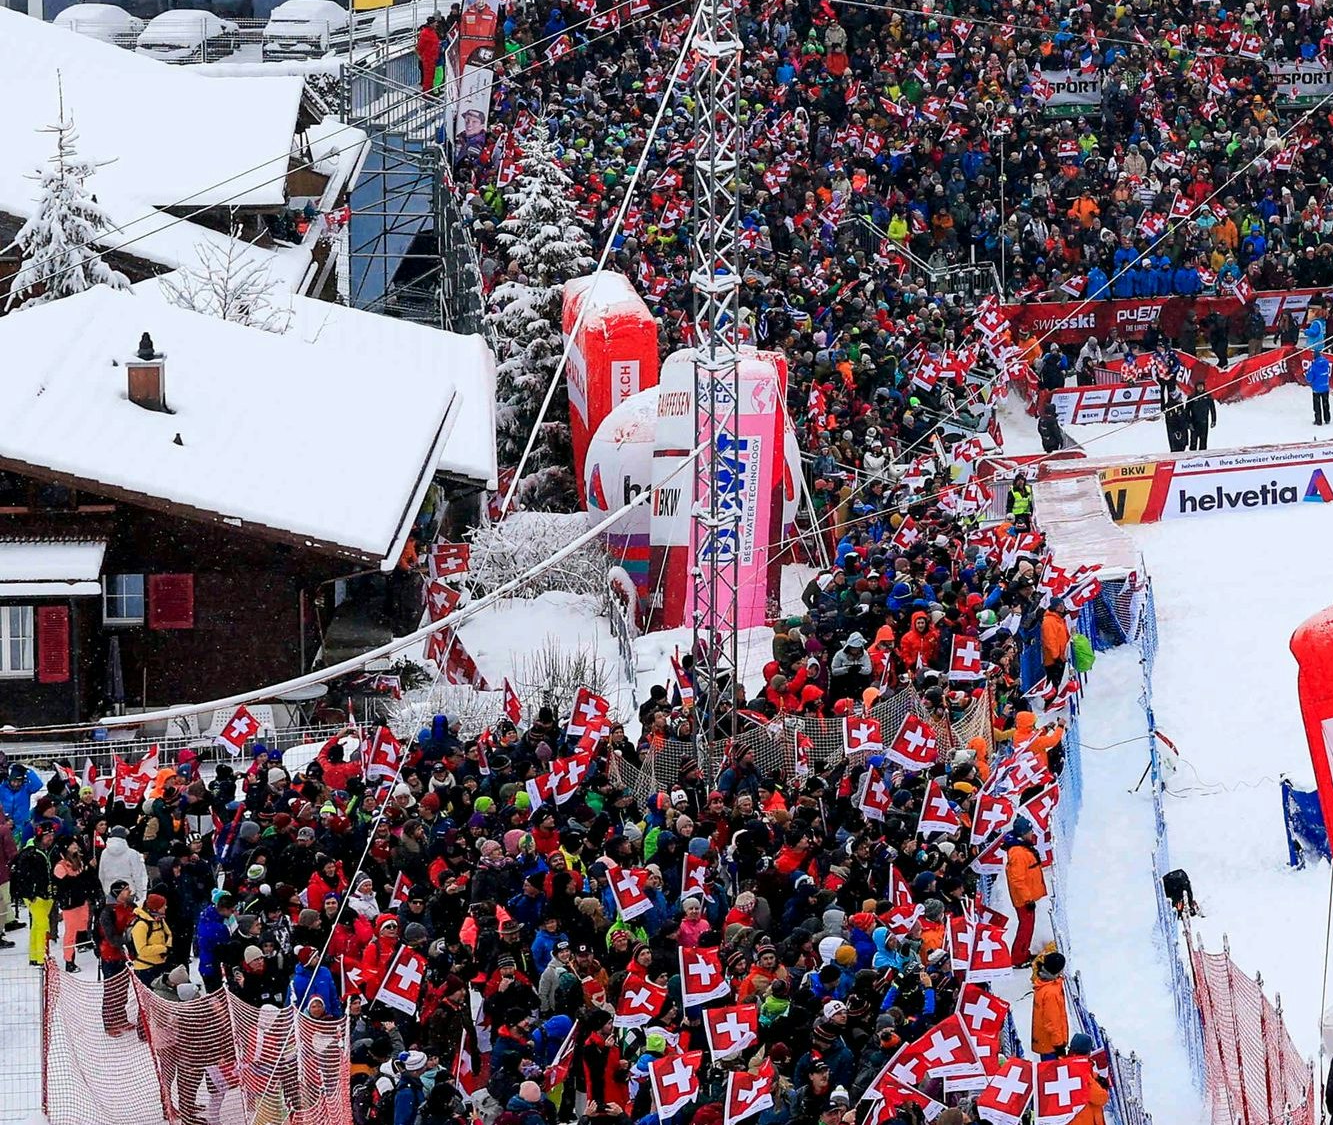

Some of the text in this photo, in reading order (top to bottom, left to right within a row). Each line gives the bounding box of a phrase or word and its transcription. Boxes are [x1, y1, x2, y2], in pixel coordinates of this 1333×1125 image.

[1033, 313, 1095, 332] swissski
[1235, 456, 1269, 465] Schweizer
[1270, 451, 1314, 462] Versicherung
[1121, 466, 1146, 476] BKW
[659, 488, 681, 517] BKW
[743, 438, 760, 563] BEST WATER TECHNOLOGY
